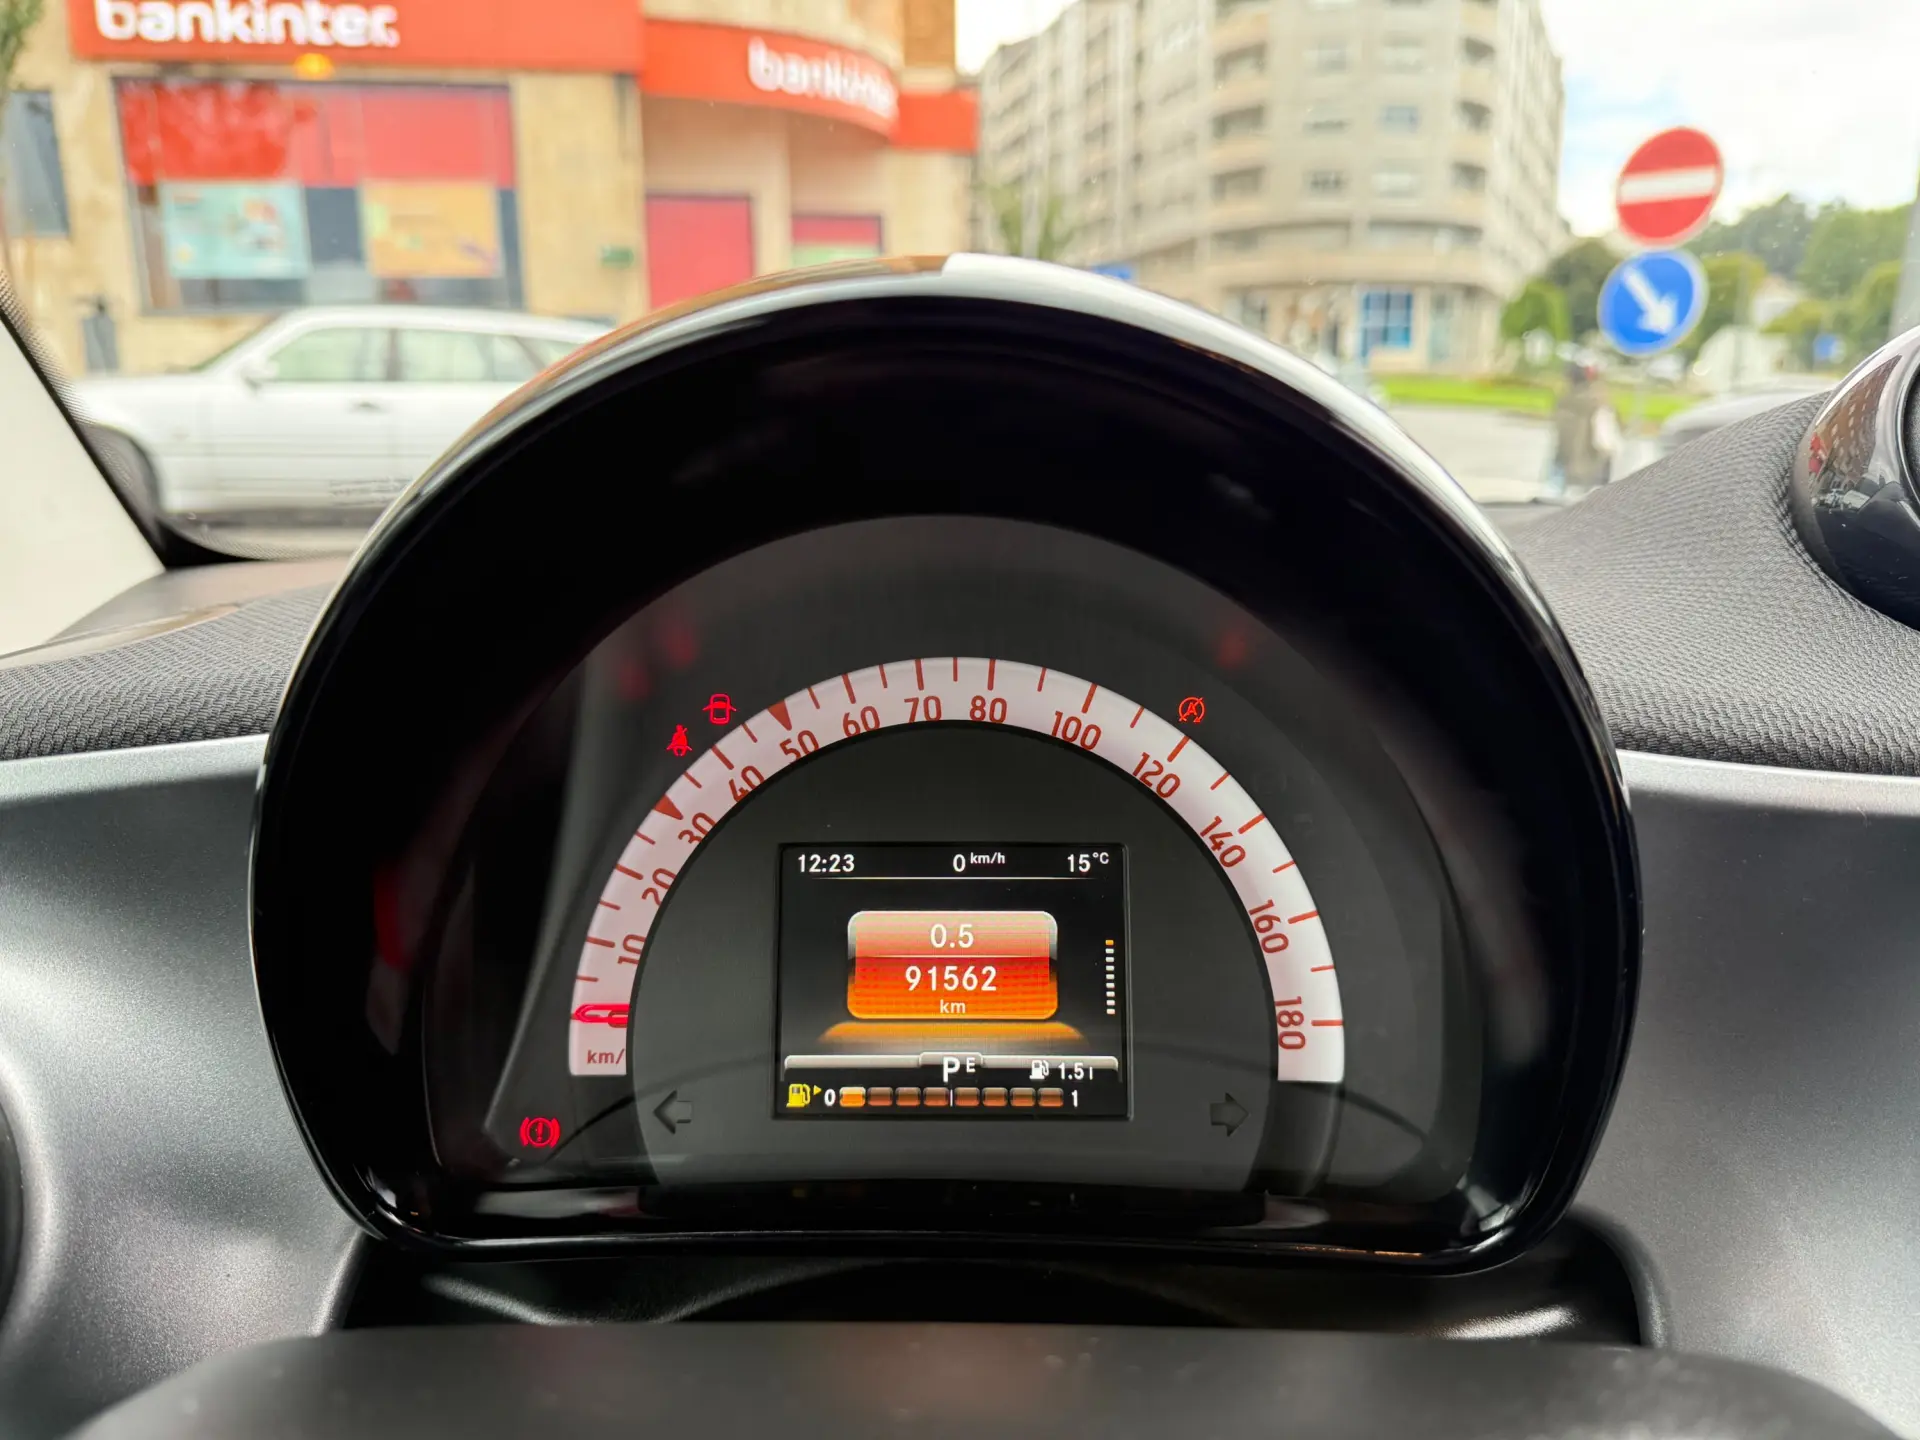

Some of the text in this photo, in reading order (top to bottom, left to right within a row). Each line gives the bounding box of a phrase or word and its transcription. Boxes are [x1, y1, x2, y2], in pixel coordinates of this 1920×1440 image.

[842, 706, 880, 738] 60
[904, 696, 942, 723] 70
[969, 695, 1008, 724] 80
[1051, 711, 1102, 751] 100
[779, 730, 819, 765] 50
[728, 766, 765, 803] 40
[1132, 752, 1181, 799] 120
[678, 812, 716, 845] 30
[1200, 816, 1246, 868] 140
[798, 854, 855, 873] 12:23
[953, 853, 1006, 872] 0 km/h
[641, 868, 677, 906] 20
[930, 924, 974, 949] 0.5
[1249, 900, 1289, 955] 160
[617, 934, 646, 965] 10
[905, 966, 997, 992] 91562
[939, 1000, 966, 1014] km
[1274, 996, 1306, 1051] 180
[942, 1057, 976, 1083] P E
[1057, 1062, 1084, 1080] 1.5
[824, 1089, 836, 1106] 0
[1071, 1089, 1079, 1107] 1
